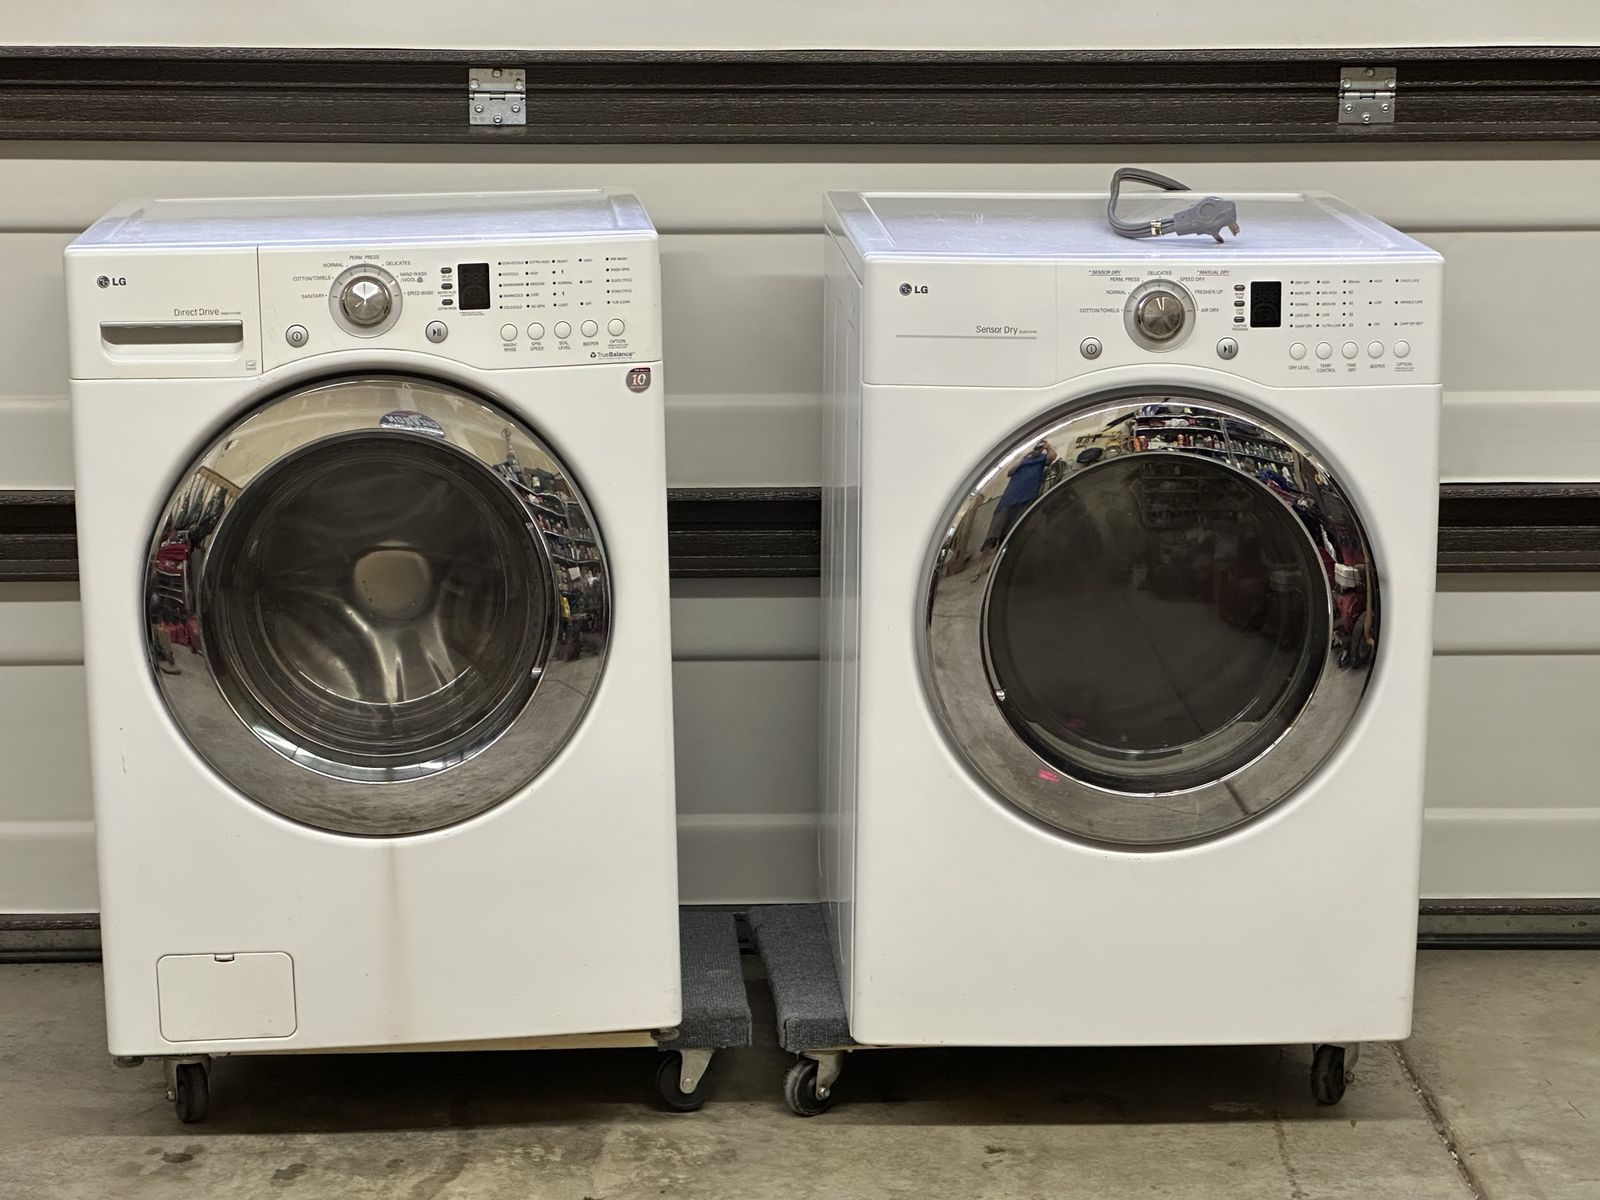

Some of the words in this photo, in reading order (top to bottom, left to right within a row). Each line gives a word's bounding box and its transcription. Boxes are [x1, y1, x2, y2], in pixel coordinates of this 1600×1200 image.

[112, 277, 127, 286] LG
[914, 285, 928, 294] LG
[174, 308, 197, 316] Direct
[199, 308, 219, 316] Drive
[976, 325, 1002, 334] Sensor
[1004, 326, 1019, 335] Dry
[632, 373, 646, 386] 10
